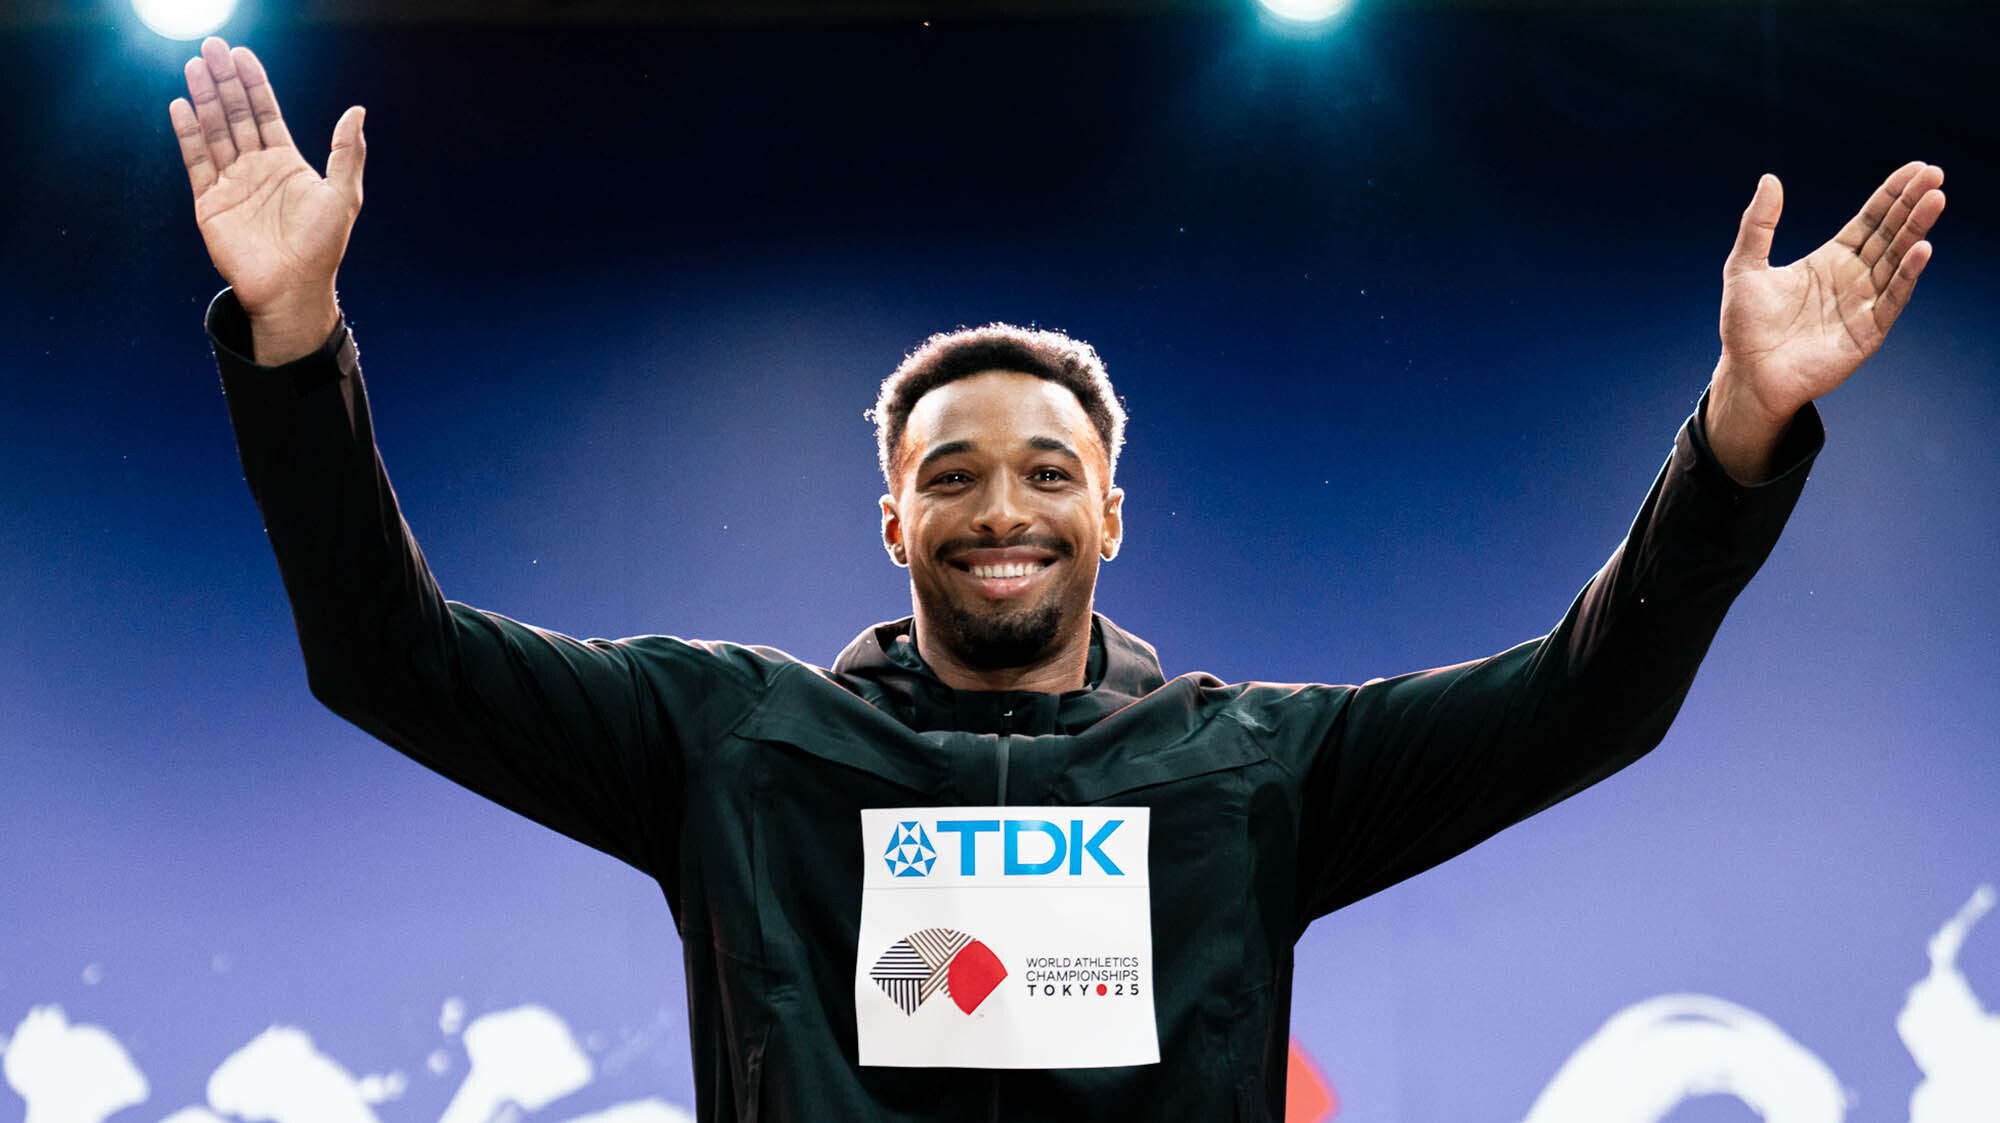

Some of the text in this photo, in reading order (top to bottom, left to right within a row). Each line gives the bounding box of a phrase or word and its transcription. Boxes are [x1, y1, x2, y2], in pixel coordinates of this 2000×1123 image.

[936, 819, 1125, 876] TDK
[1026, 957, 1139, 968] WORLD ATHLETICS
[1026, 969, 1139, 982] CHAMPIONSHIPS
